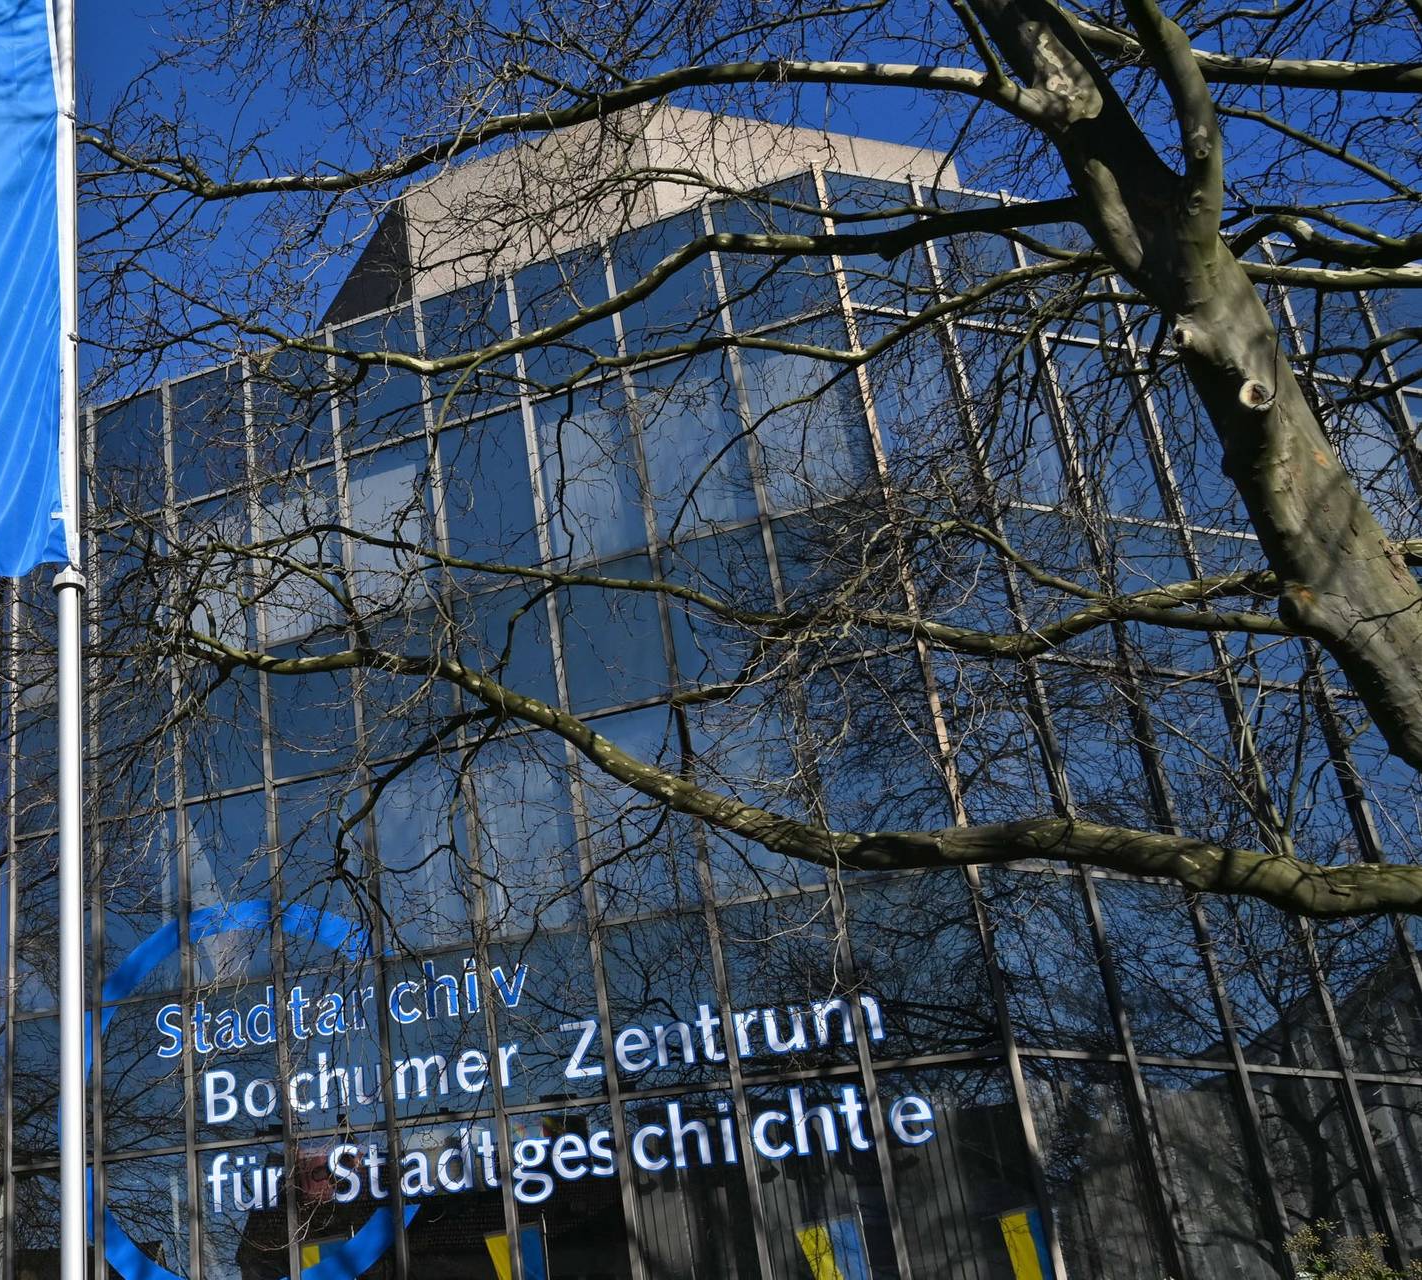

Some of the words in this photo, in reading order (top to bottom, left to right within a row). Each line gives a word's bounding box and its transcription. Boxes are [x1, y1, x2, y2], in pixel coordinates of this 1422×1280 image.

[155, 959, 529, 1058] Stadtarchiv
[204, 1041, 520, 1124] Bochumer
[559, 994, 885, 1080] Zentrum
[207, 1151, 283, 1213] für
[327, 1085, 935, 1204] Stadtgeschichte
